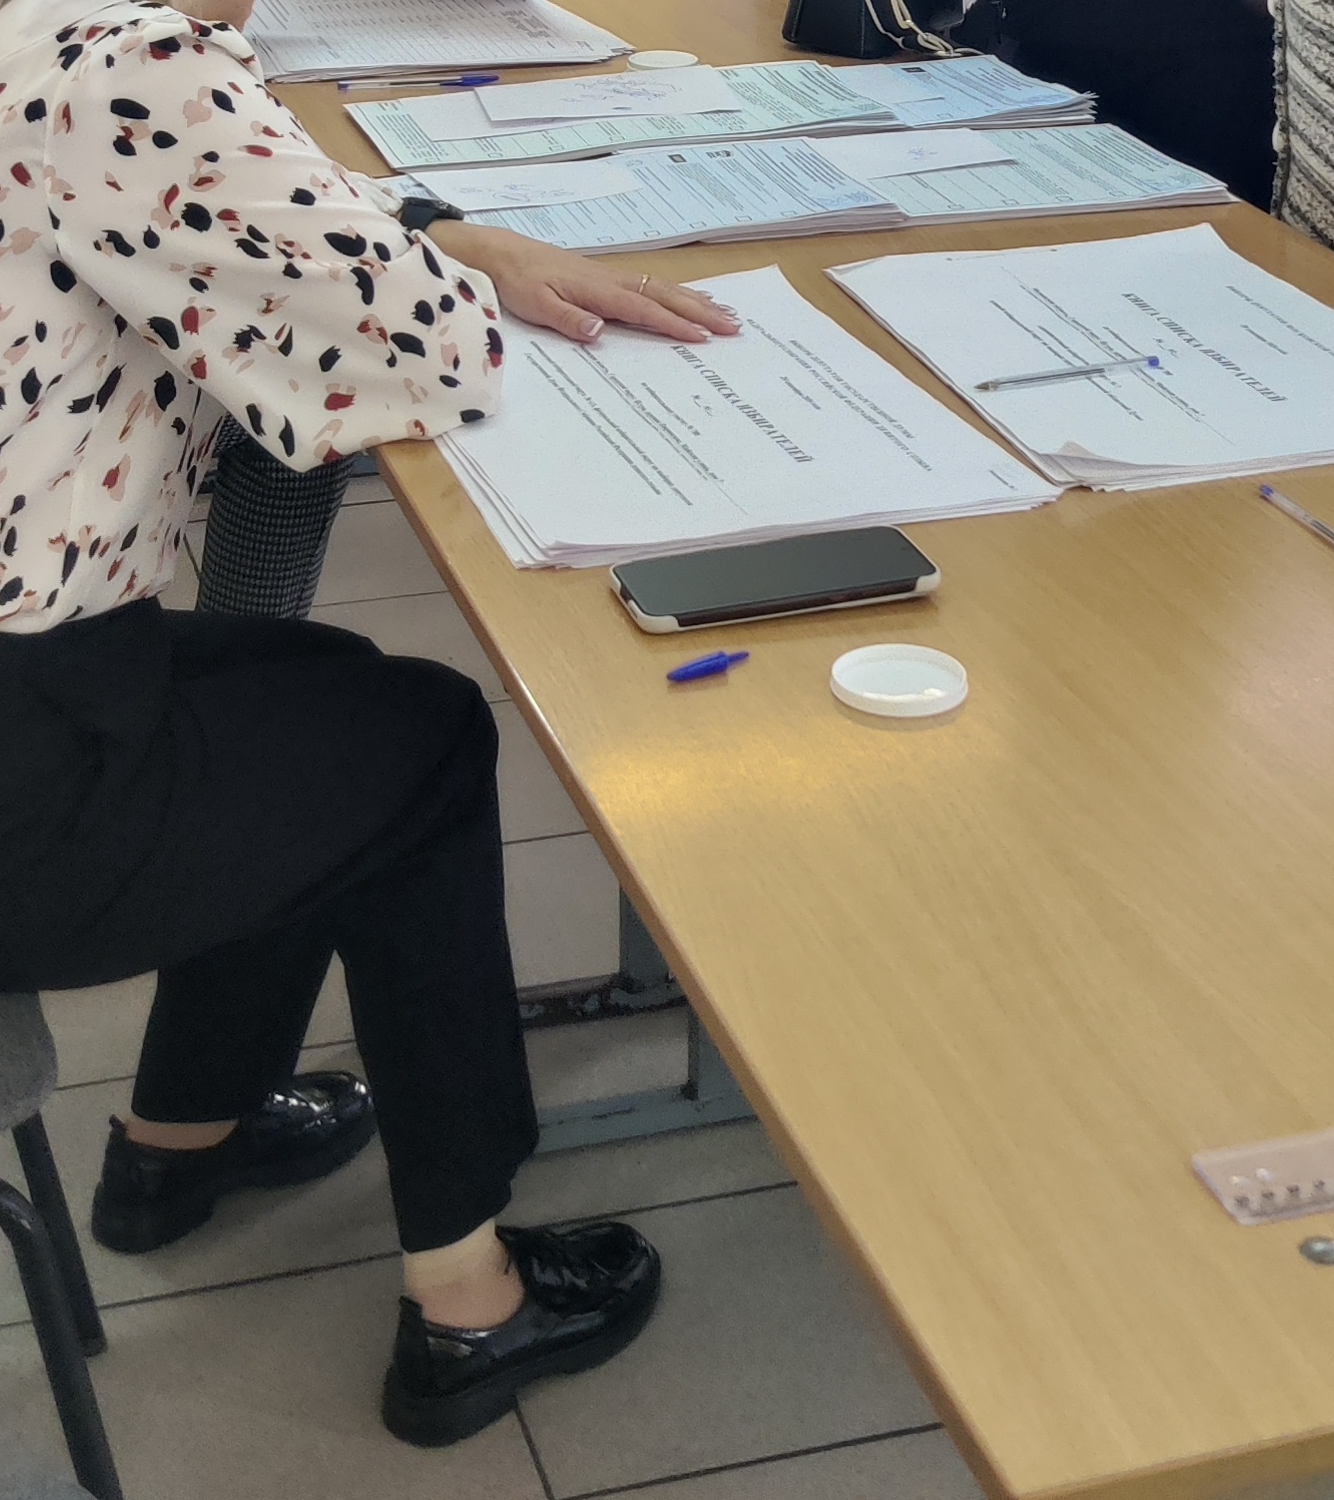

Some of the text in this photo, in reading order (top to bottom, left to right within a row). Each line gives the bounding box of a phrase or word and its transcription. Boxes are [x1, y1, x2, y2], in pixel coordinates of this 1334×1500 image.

[668, 344, 711, 369] КНИГА
[695, 369, 749, 404] СПИСКА
[733, 403, 818, 463] ИЗБИРАТЕЛЕЙ
[1117, 292, 1165, 316] КНИГА
[1150, 316, 1212, 348] СПИСКА
[1194, 348, 1292, 402] ИЗБИРАТЕЛЕЙ
